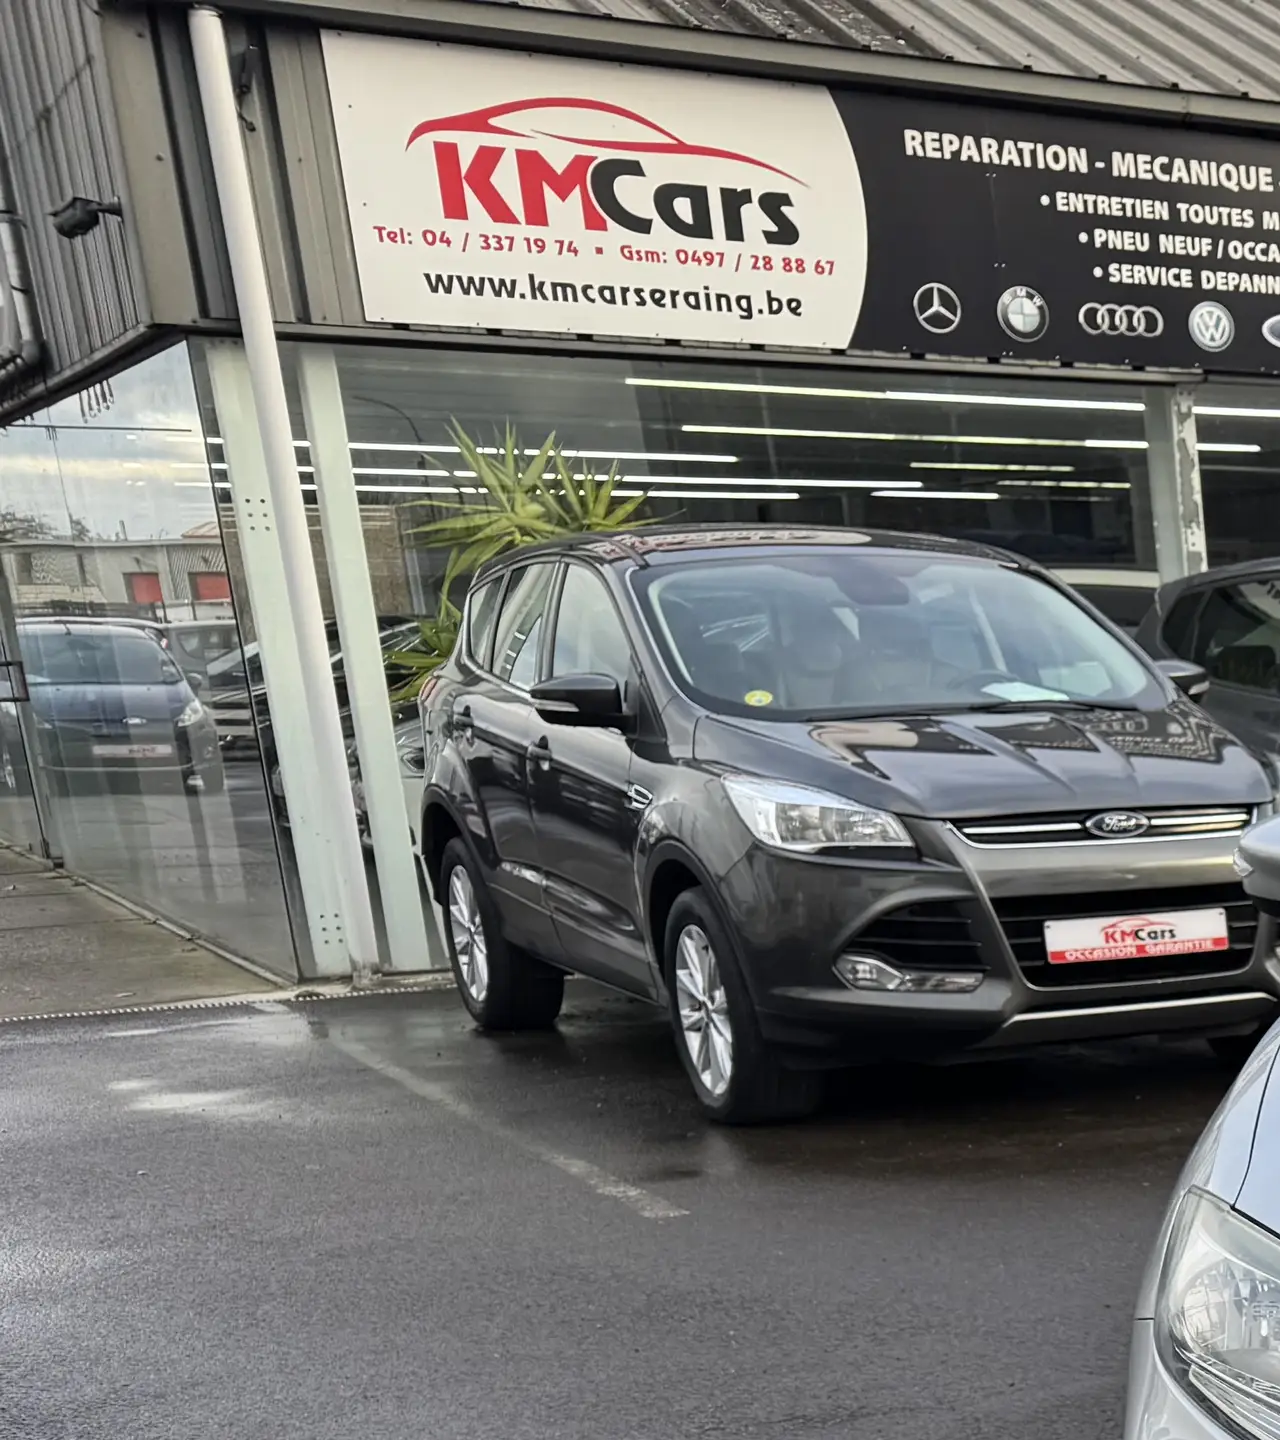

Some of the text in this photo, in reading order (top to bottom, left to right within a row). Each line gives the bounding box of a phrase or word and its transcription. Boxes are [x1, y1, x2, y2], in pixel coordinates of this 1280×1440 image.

[904, 129, 1088, 174] REPARATION
[1111, 151, 1274, 192] MECANIQUE
[433, 141, 801, 245] KMCars
[1056, 191, 1169, 220] ENTRETIEN
[1176, 202, 1254, 228] TOUTES
[373, 226, 413, 245] Tel:
[422, 229, 452, 248] 04
[479, 234, 515, 252] 337
[523, 237, 546, 254] 19
[554, 240, 579, 257] 74
[620, 244, 667, 263] Gsm:
[675, 249, 725, 267] 0497
[750, 255, 774, 271] 28
[781, 257, 806, 274] 88
[814, 259, 835, 276] 67
[1093, 228, 1150, 252] PNEU
[1159, 233, 1212, 257] NEUF
[1108, 263, 1193, 288] SERVICE
[423, 273, 802, 320] www.kmcarseraing.be
[1102, 815, 1137, 831] Ford
[1065, 939, 1214, 961] OCCASION GARANTIE
[1104, 927, 1177, 945] KMCars
